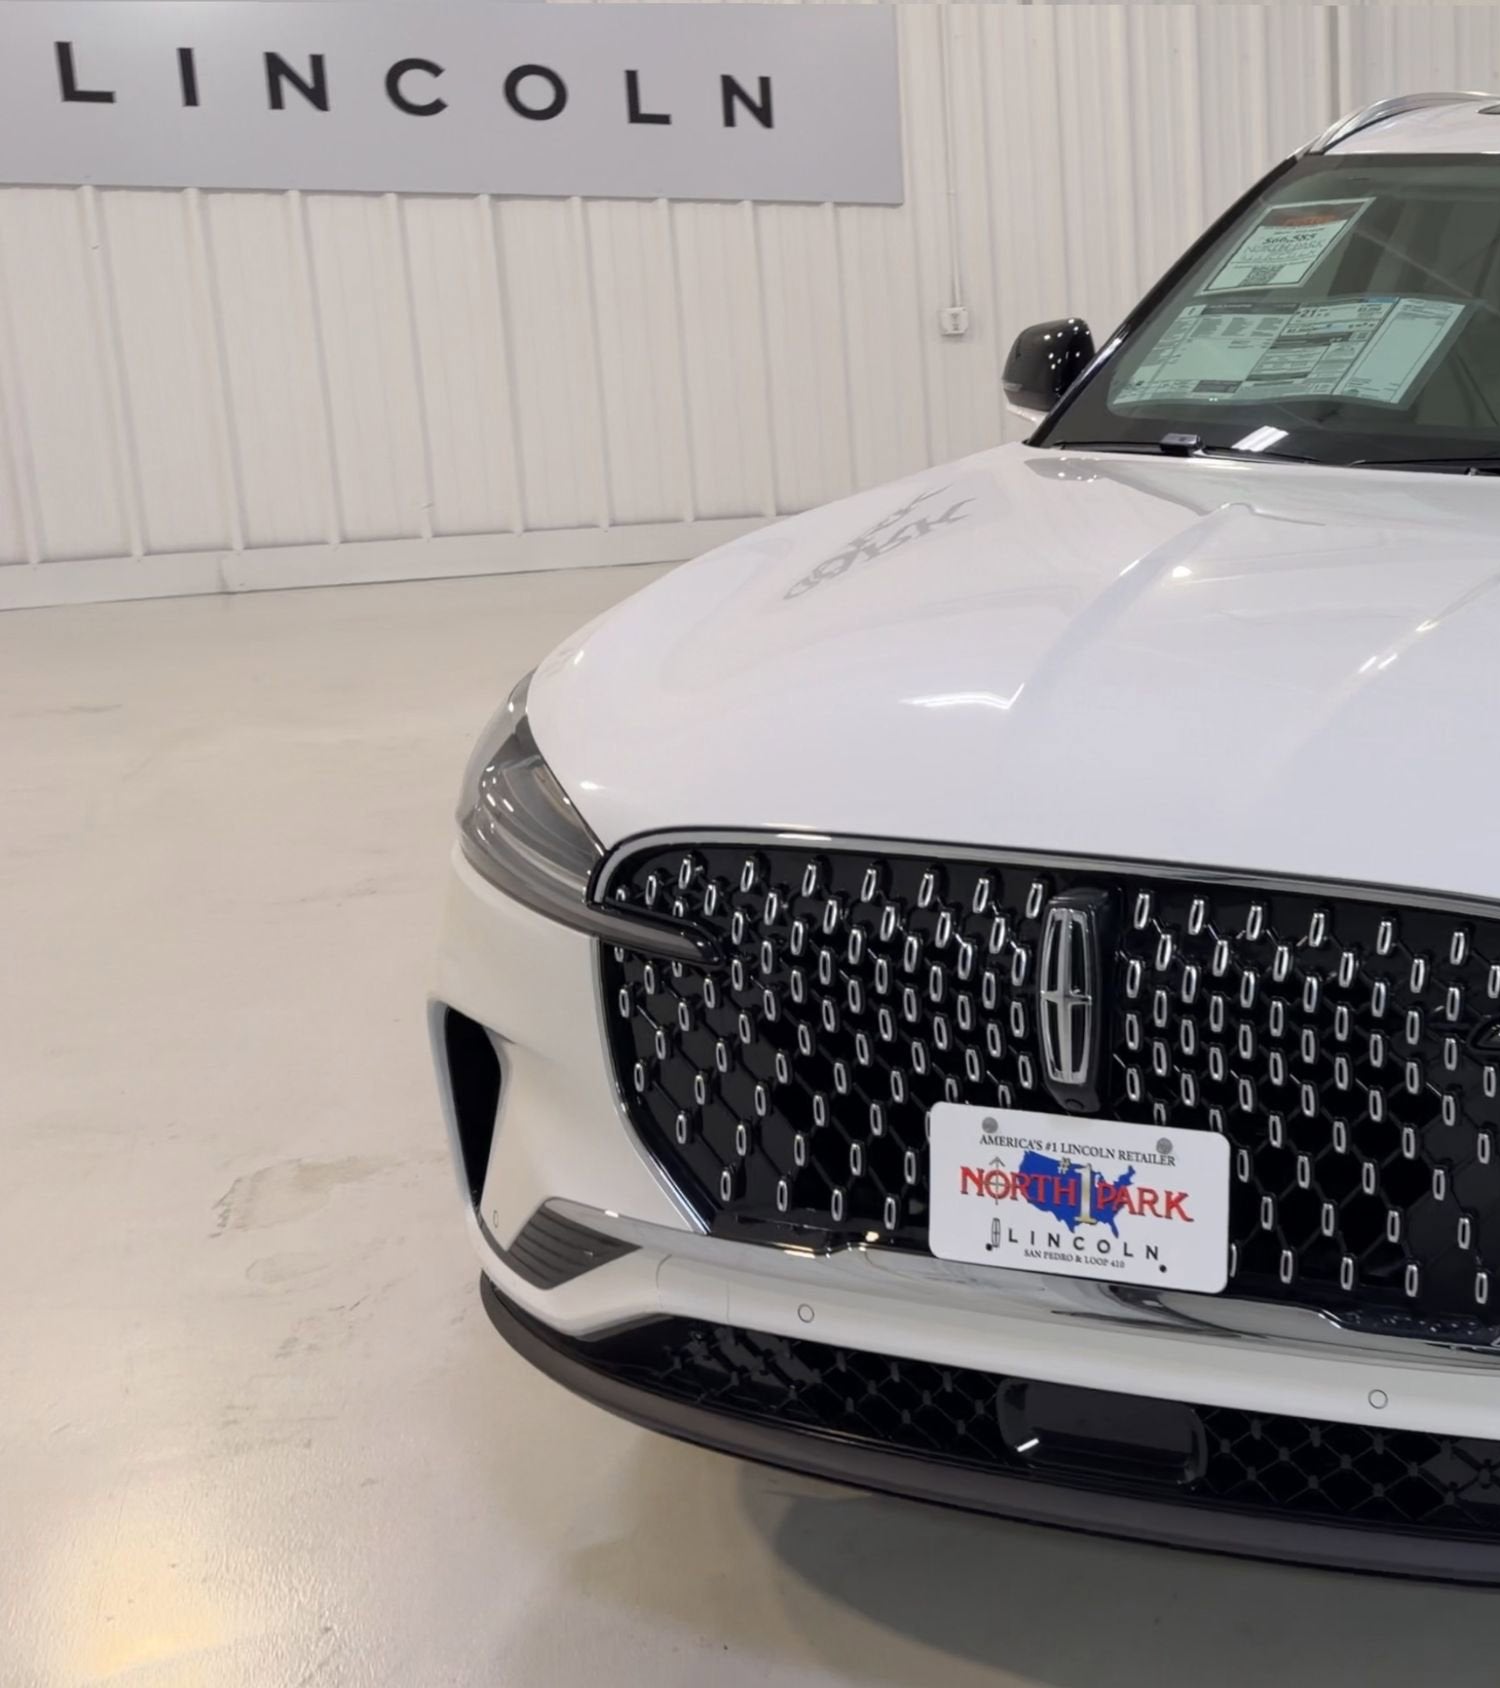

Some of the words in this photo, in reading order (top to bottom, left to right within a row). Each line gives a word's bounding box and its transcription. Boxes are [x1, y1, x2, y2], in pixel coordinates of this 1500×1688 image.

[55, 42, 774, 129] LINCOLN
[979, 1134, 1043, 1151] AMERICA'S
[1045, 1142, 1057, 1152] #1
[1060, 1144, 1115, 1160] LINCOLN
[1118, 1150, 1176, 1167] RETAILER
[960, 1166, 1077, 1206] NORTH
[1096, 1180, 1194, 1222] PARK
[1008, 1228, 1159, 1261] LINCOLN
[1024, 1249, 1041, 1259] SAN
[1044, 1252, 1073, 1263] PEDRO
[1075, 1255, 1082, 1263] &
[1084, 1257, 1110, 1267] LOOP
[1110, 1260, 1126, 1269] 410
